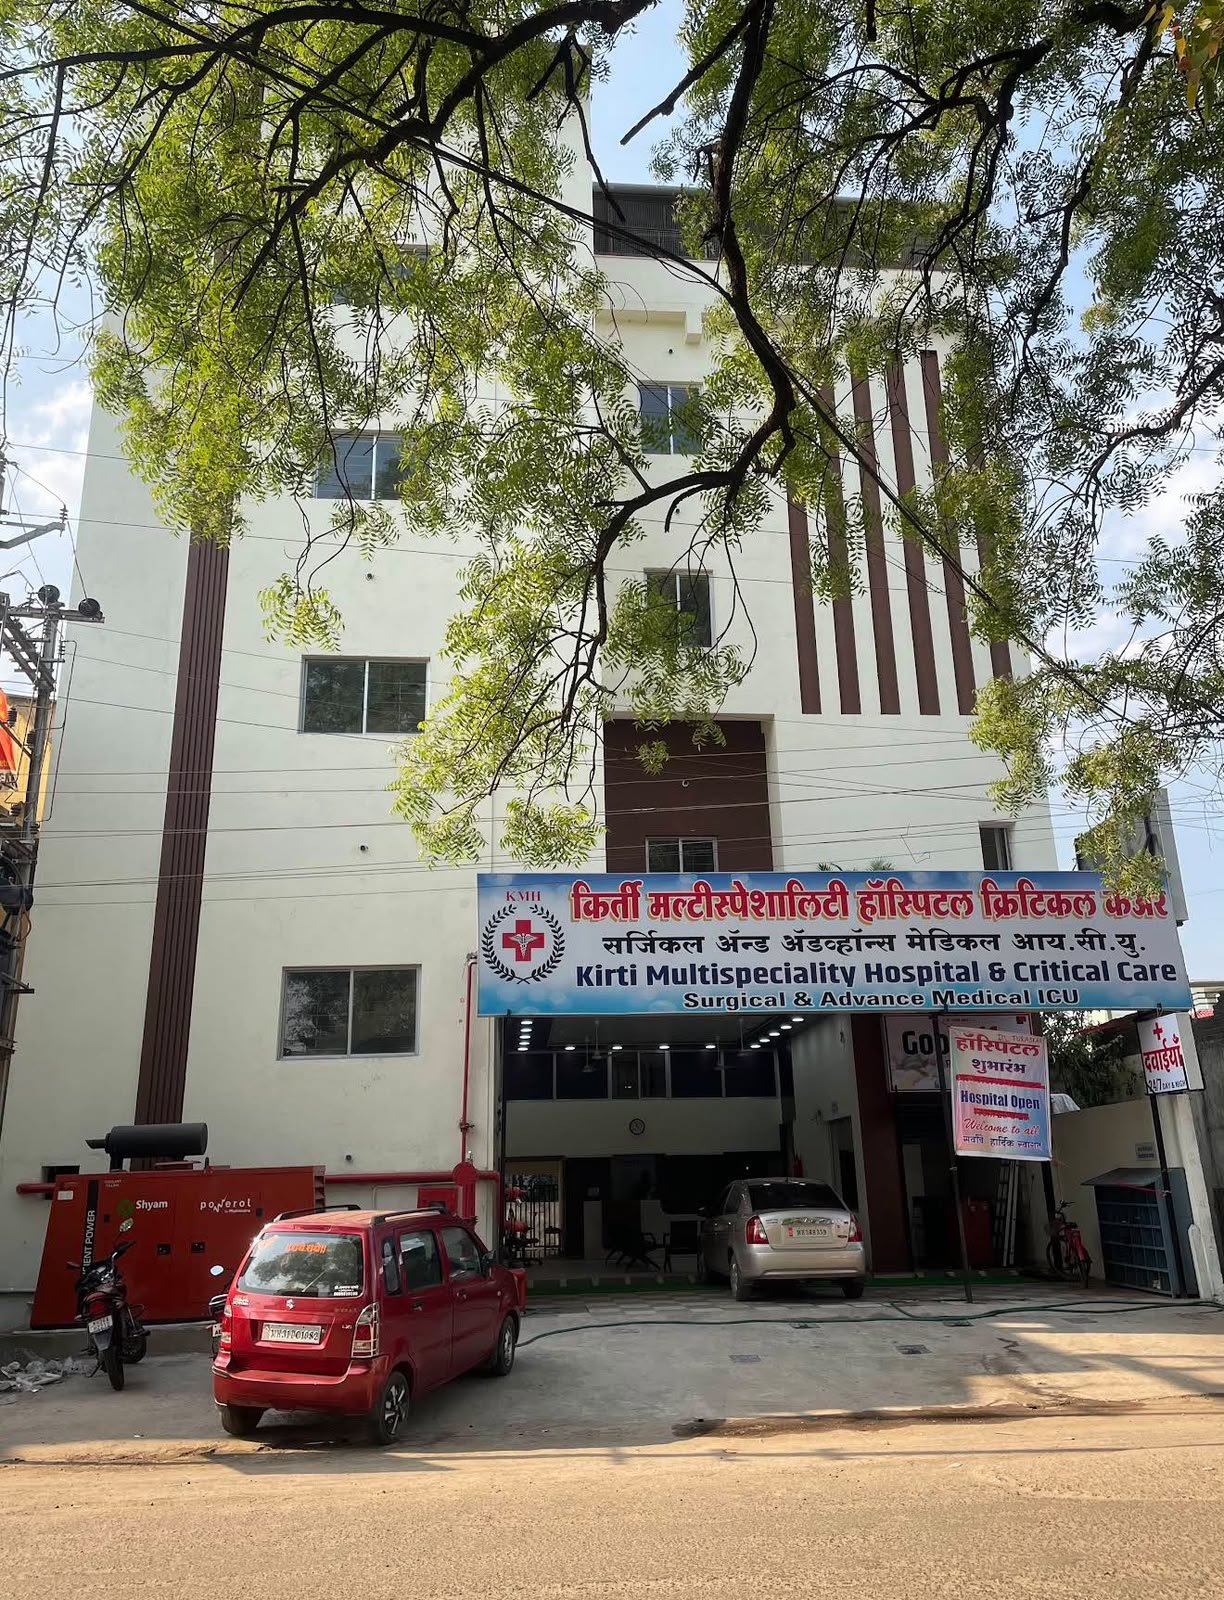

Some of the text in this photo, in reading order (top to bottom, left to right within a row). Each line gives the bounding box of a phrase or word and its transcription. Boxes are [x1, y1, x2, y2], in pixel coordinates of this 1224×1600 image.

[506, 890, 541, 902] KMH
[570, 880, 643, 922] किर्ती
[648, 879, 849, 922] मल्टीस्पेशालिटी
[856, 878, 974, 924] हॉस्पिटल
[981, 878, 1096, 921] क्रिटिकल
[602, 930, 705, 955] सर्जिकल
[905, 928, 1000, 952] मेडिकल
[576, 960, 1177, 989] Kirti Multispeciality Hospital & Critical Care
[684, 989, 1079, 1011] Surgical & Advance Medical ICU
[955, 1033, 1040, 1056] हॉस्पिटल
[972, 1059, 1027, 1074] शुभारंभ
[961, 1089, 1040, 1110] Hospital Open
[963, 1118, 1040, 1136] Welcome to all
[135, 1200, 168, 1211] Shyam
[85, 1210, 96, 1245] POWER
